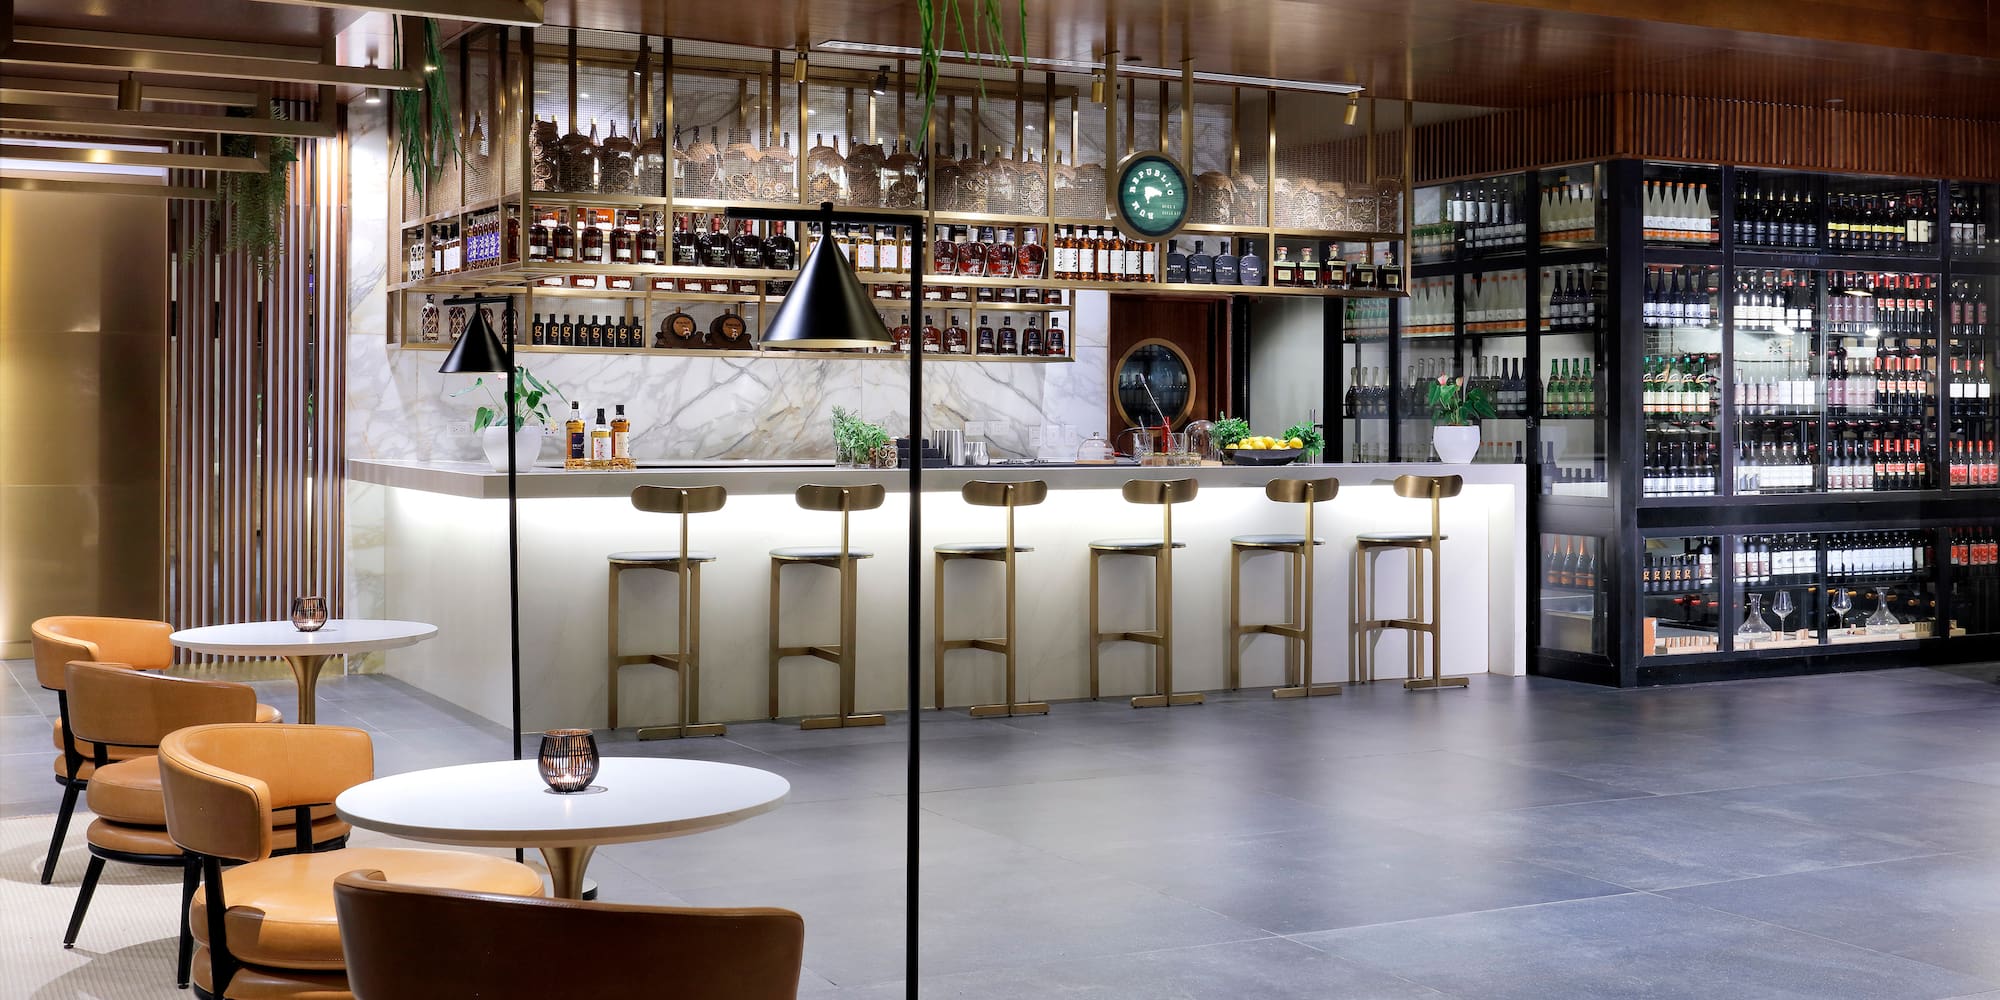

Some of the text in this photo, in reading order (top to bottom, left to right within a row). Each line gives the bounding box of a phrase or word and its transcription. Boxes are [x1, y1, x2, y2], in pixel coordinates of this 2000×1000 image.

[1132, 200, 1154, 220] RUM
[534, 326, 542, 337] g
[551, 326, 558, 337] g
[563, 326, 571, 338] g
[580, 327, 587, 338] g
[593, 327, 600, 338] g
[607, 328, 614, 339] g
[620, 328, 627, 339] g
[634, 329, 640, 339] g
